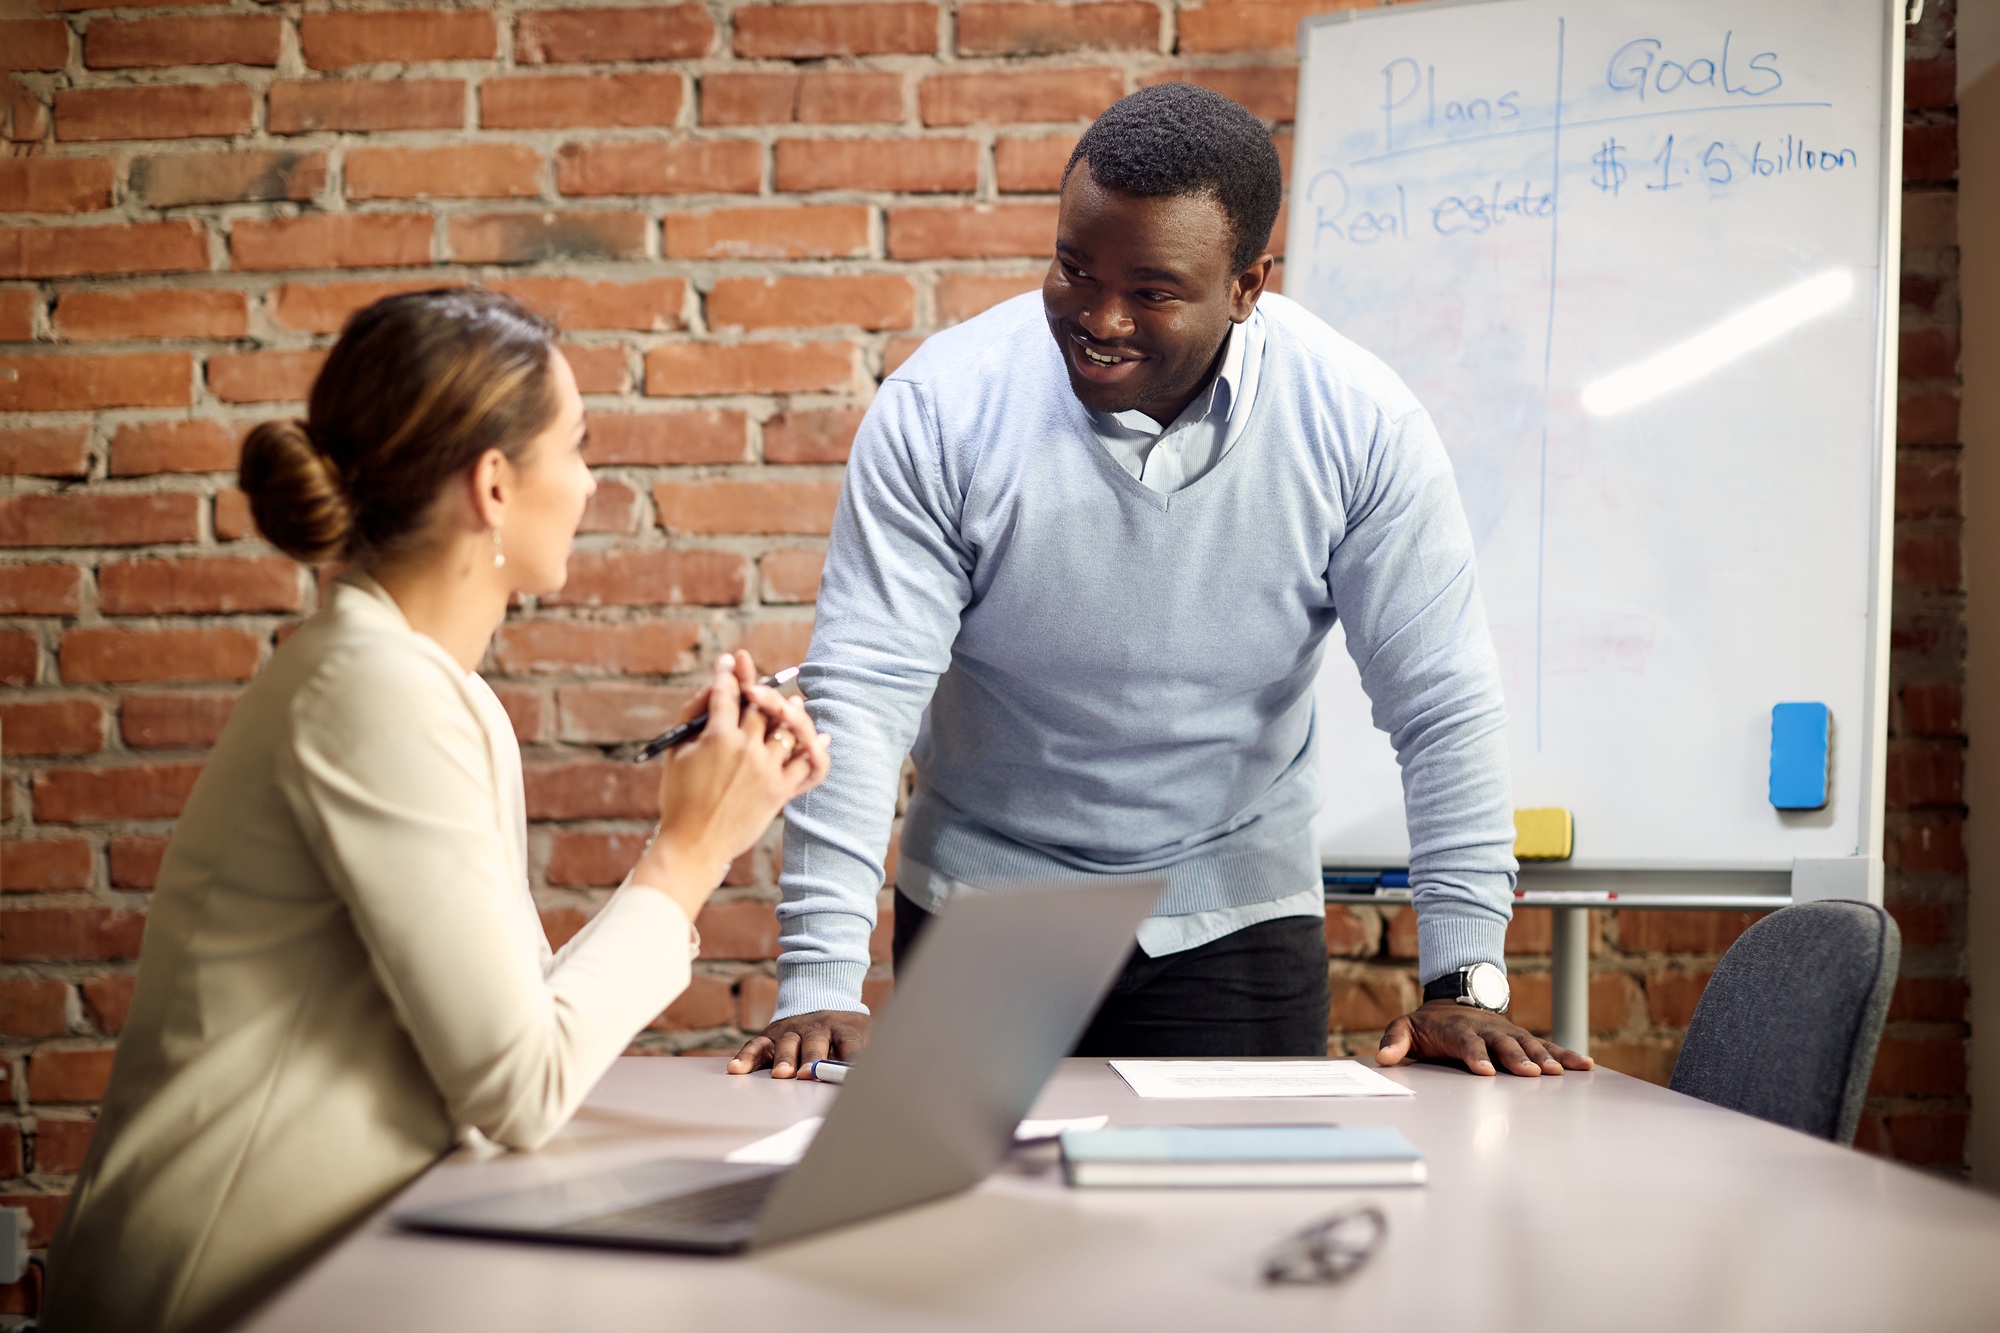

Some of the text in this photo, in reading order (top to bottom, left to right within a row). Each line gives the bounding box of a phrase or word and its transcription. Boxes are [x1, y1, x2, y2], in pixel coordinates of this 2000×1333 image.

[1379, 57, 1520, 152] Plans
[1607, 30, 1783, 102] Goals
[1306, 168, 1408, 250] Real
